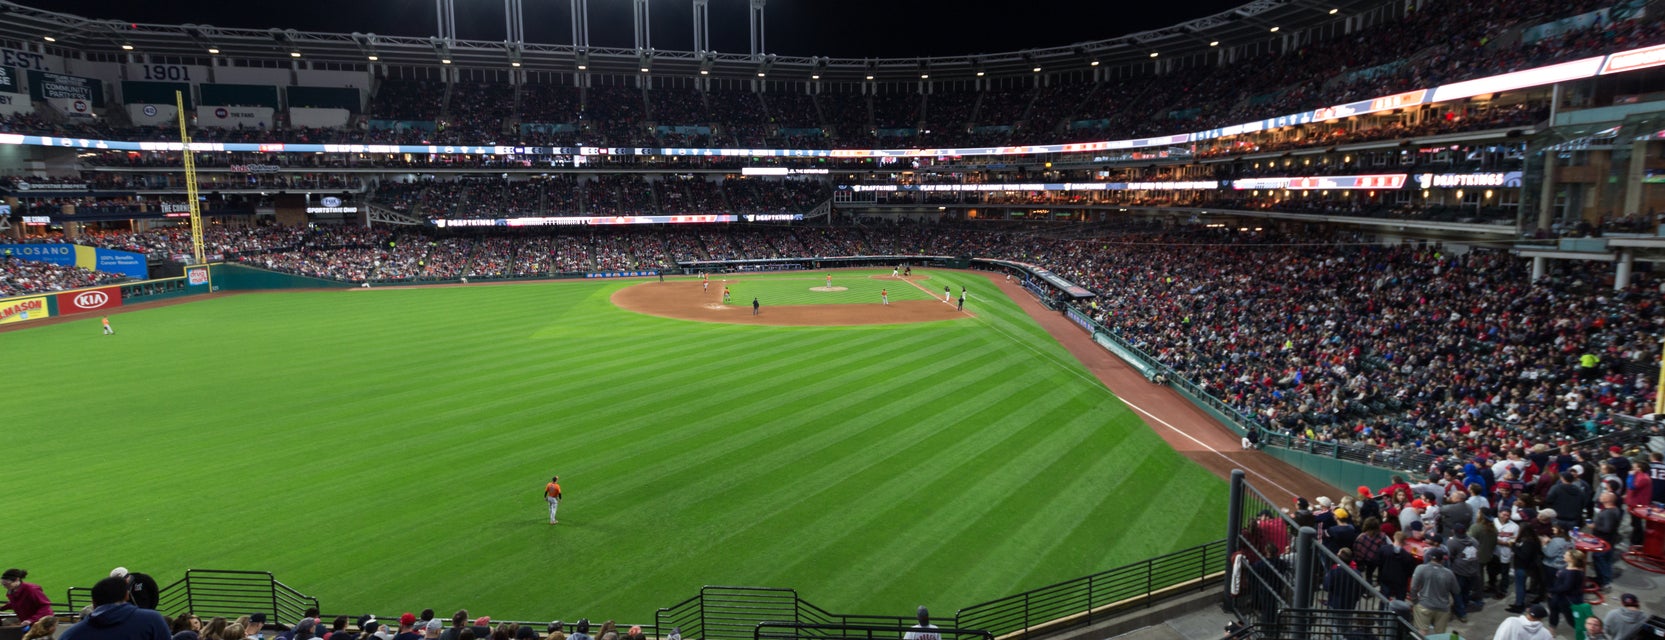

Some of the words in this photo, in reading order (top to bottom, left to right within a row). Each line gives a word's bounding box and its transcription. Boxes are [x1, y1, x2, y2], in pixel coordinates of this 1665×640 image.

[2, 48, 49, 72] EST.
[143, 64, 191, 81] 1901
[45, 83, 89, 94] COMMUNITY
[1433, 173, 1504, 186] DRAFTKINGS
[161, 203, 173, 213] THE
[80, 293, 103, 306] KIA
